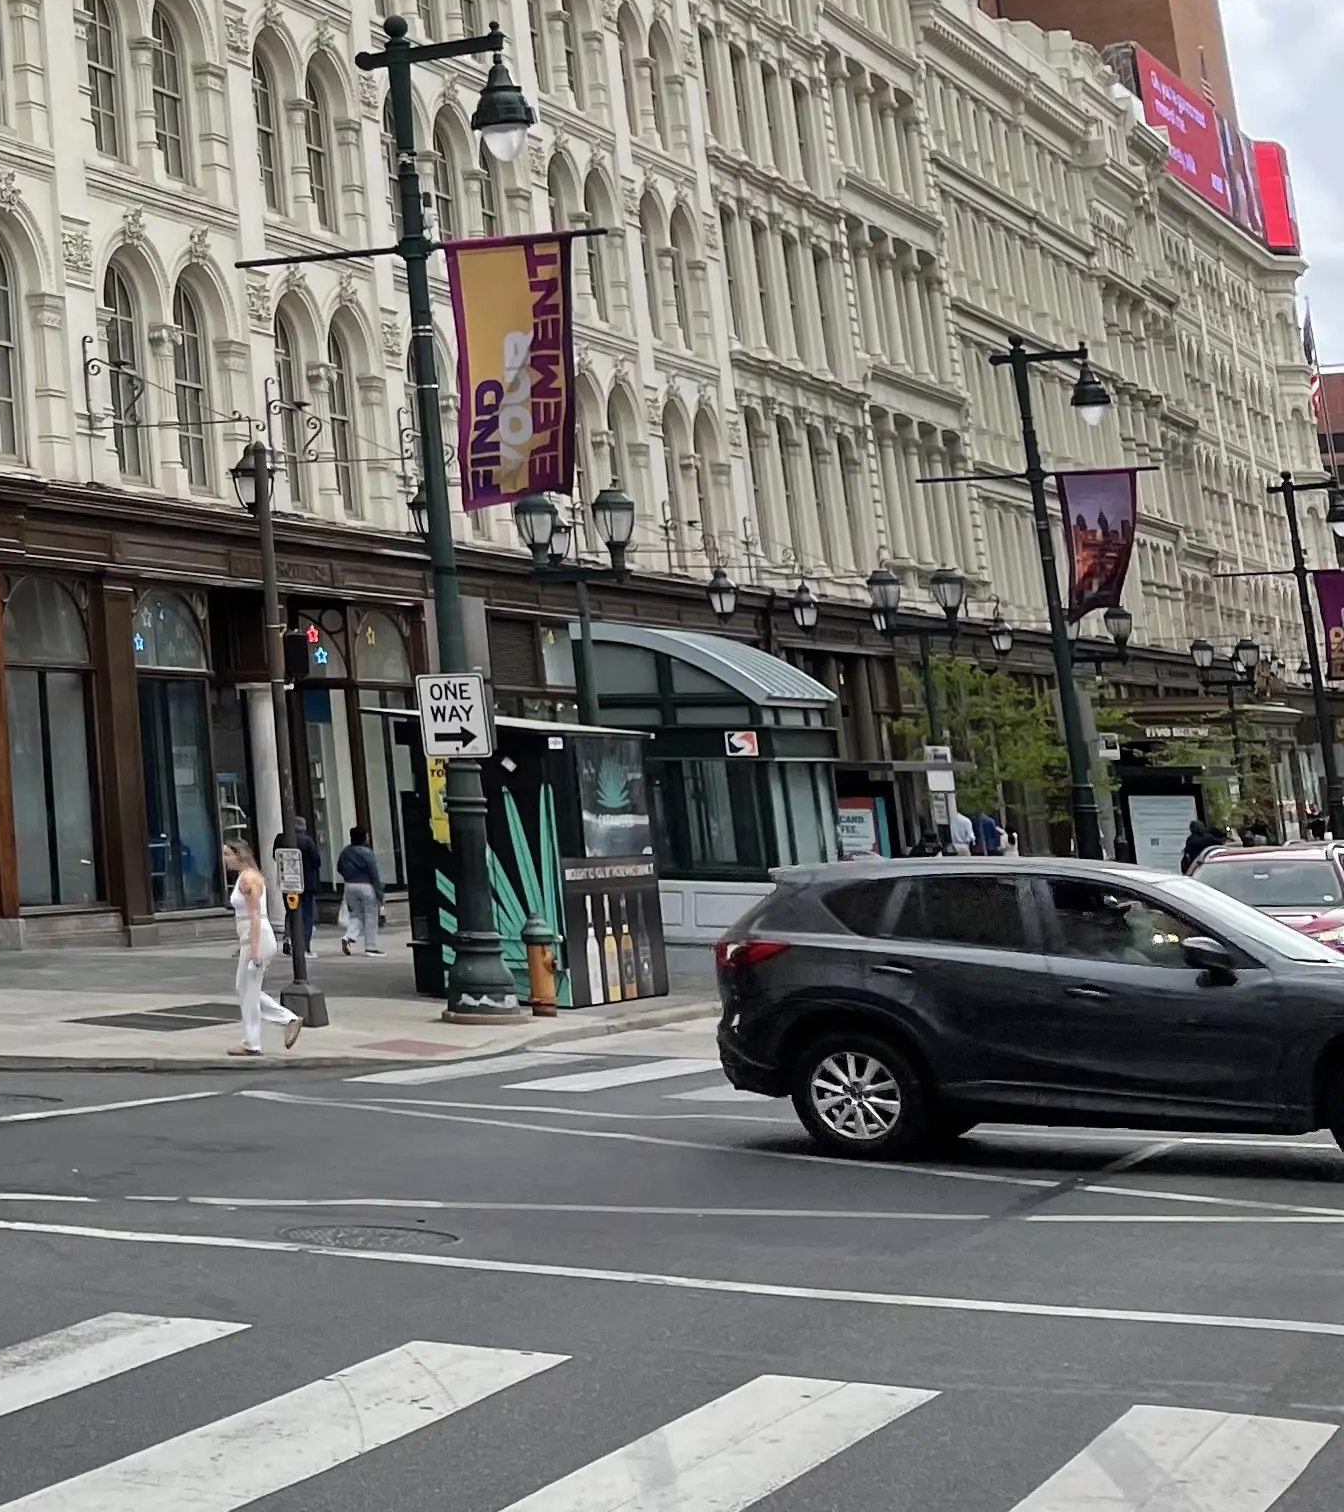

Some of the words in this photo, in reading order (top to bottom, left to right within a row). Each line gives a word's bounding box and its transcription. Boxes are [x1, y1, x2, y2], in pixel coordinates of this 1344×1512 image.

[523, 242, 562, 483] ELEMENT
[470, 379, 504, 498] FIND
[429, 682, 471, 701] ONE
[430, 704, 474, 723] WAY
